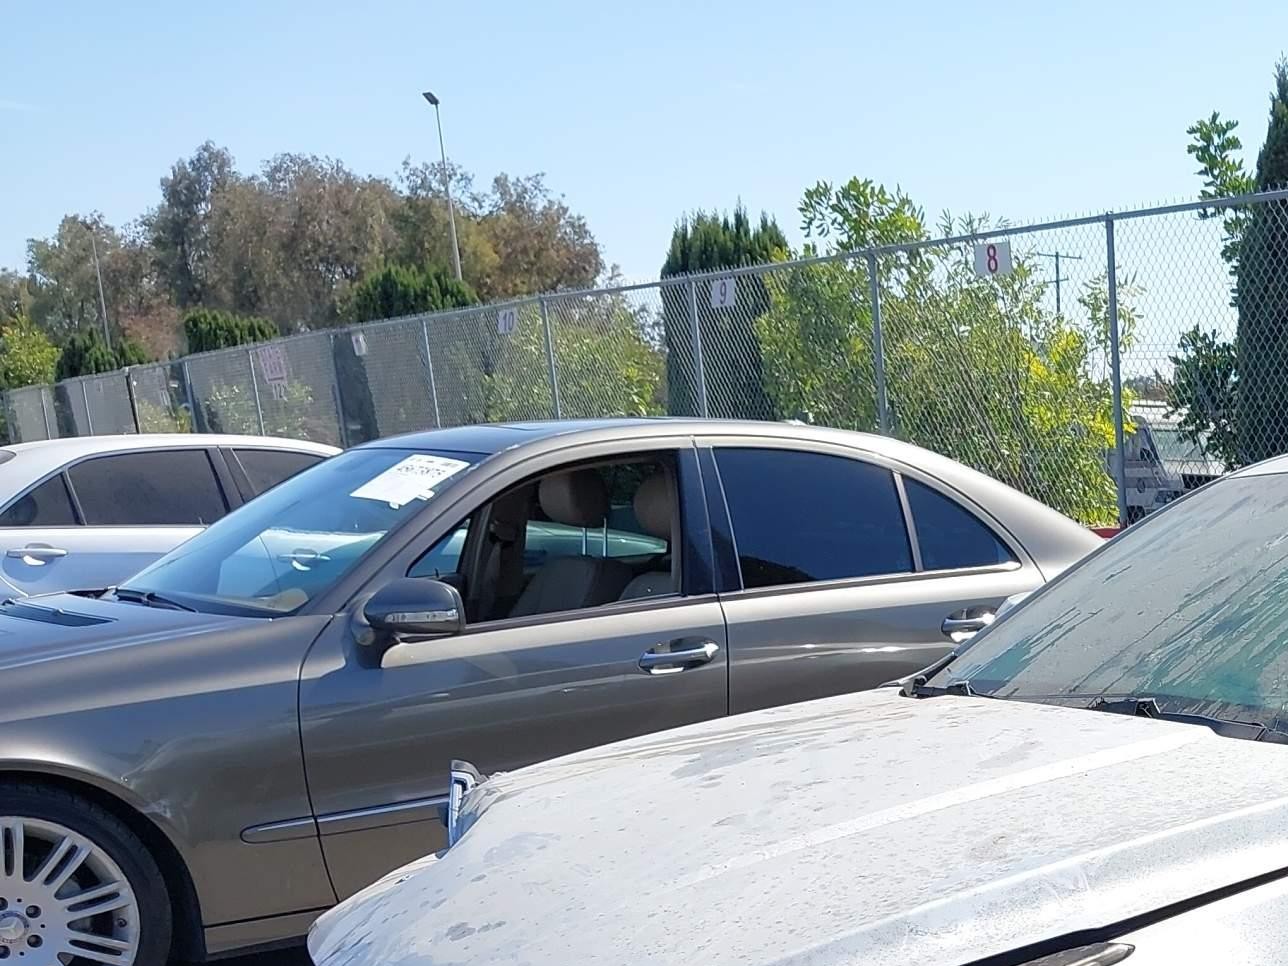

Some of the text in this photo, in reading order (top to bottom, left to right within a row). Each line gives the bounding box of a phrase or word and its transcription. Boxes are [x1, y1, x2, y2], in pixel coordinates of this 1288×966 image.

[986, 244, 998, 274] 8
[719, 280, 727, 305] 9
[502, 310, 515, 332] 10
